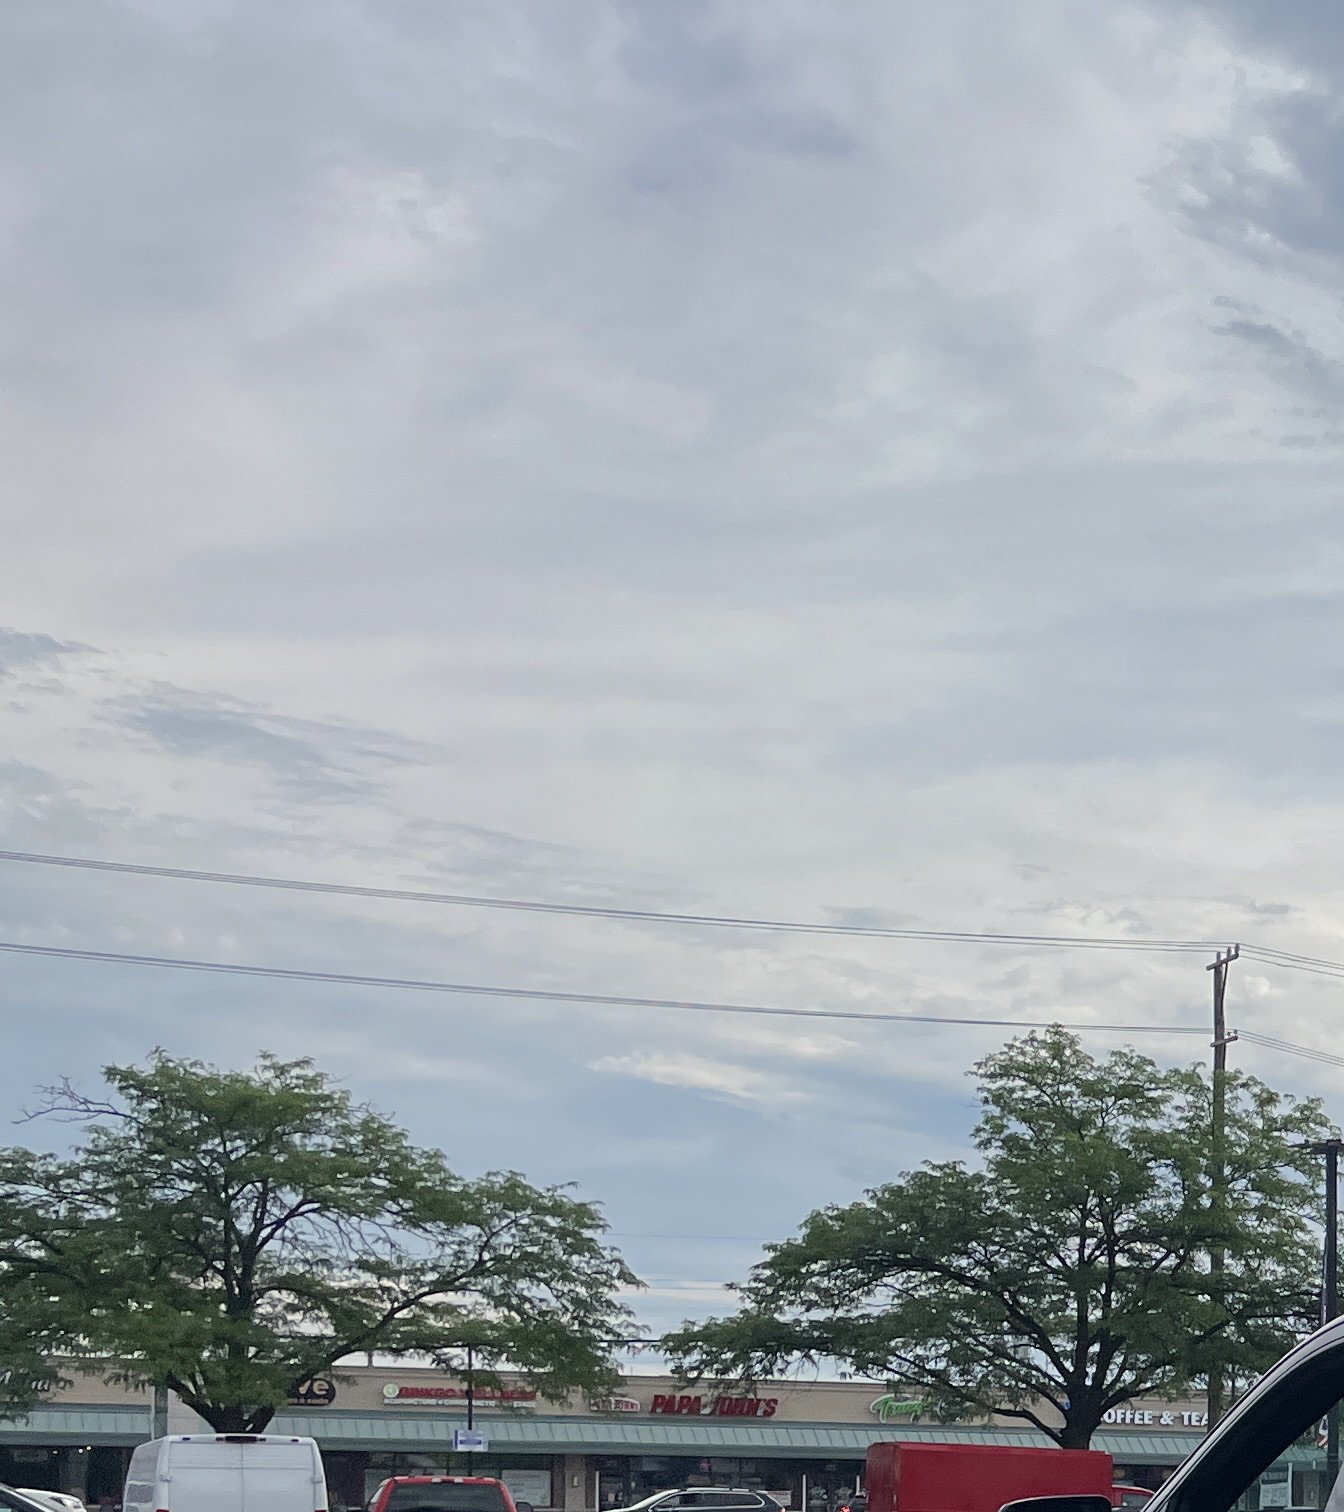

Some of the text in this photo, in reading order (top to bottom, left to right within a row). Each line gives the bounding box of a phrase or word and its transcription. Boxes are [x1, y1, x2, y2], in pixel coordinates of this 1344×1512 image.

[650, 1394, 702, 1415] PAPA
[1101, 1408, 1154, 1425] OFFEE
[1159, 1410, 1175, 1426] &
